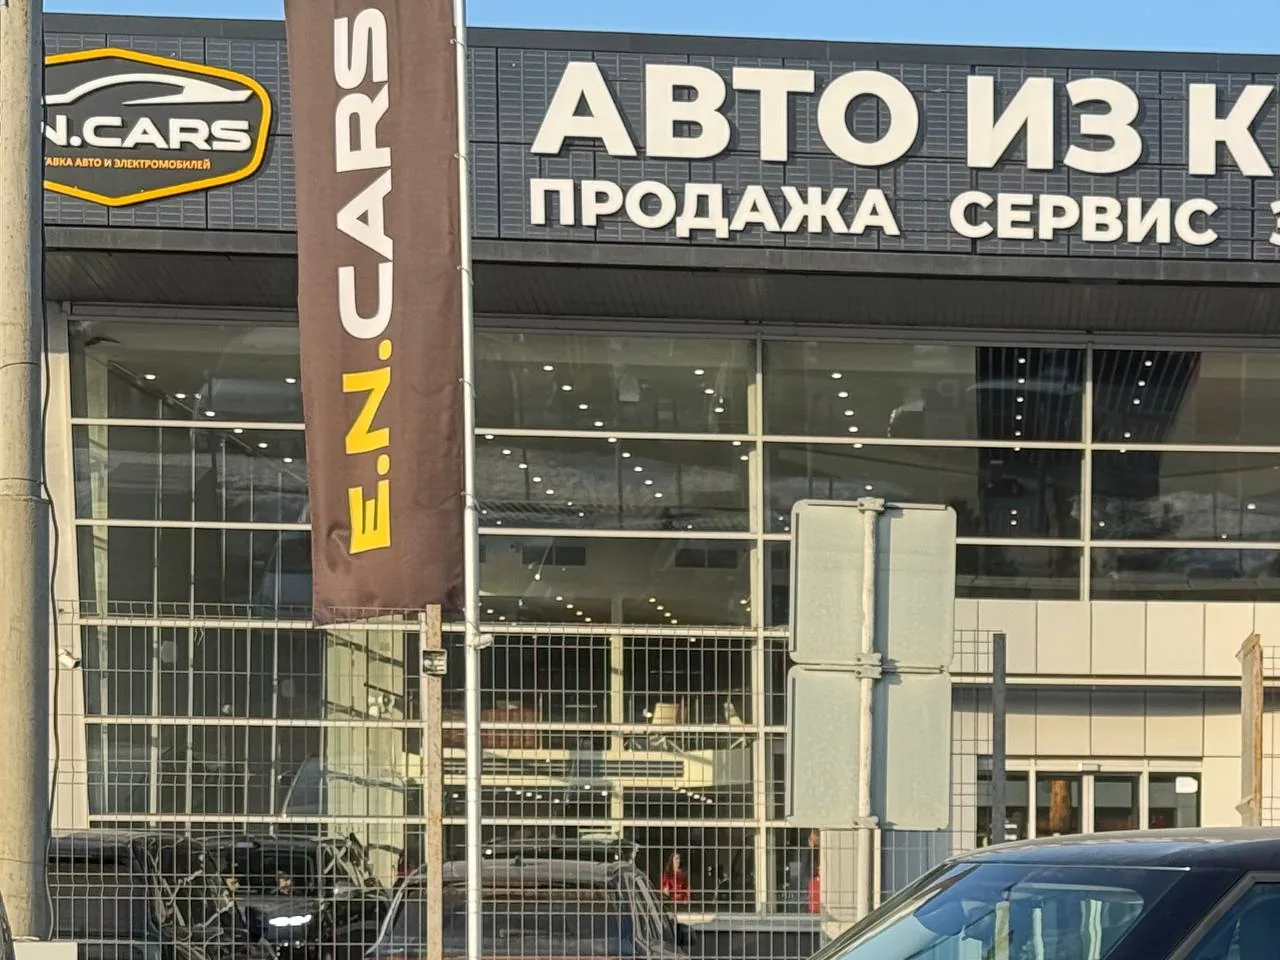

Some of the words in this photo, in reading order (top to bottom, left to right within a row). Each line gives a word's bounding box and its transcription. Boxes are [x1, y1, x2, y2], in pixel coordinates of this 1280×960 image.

[530, 60, 919, 167] АВТО
[966, 75, 1142, 174] ИЗ
[44, 156, 74, 167] АВКА
[75, 157, 102, 168] АВТО
[104, 158, 112, 168] И
[114, 158, 212, 170] ЭЛЕКТРОМОБИЛЕЙ
[529, 177, 900, 239] ПРОДАЖА
[949, 190, 1219, 246] СЕРВИС
[334, 8, 394, 555] E.N.CARS
